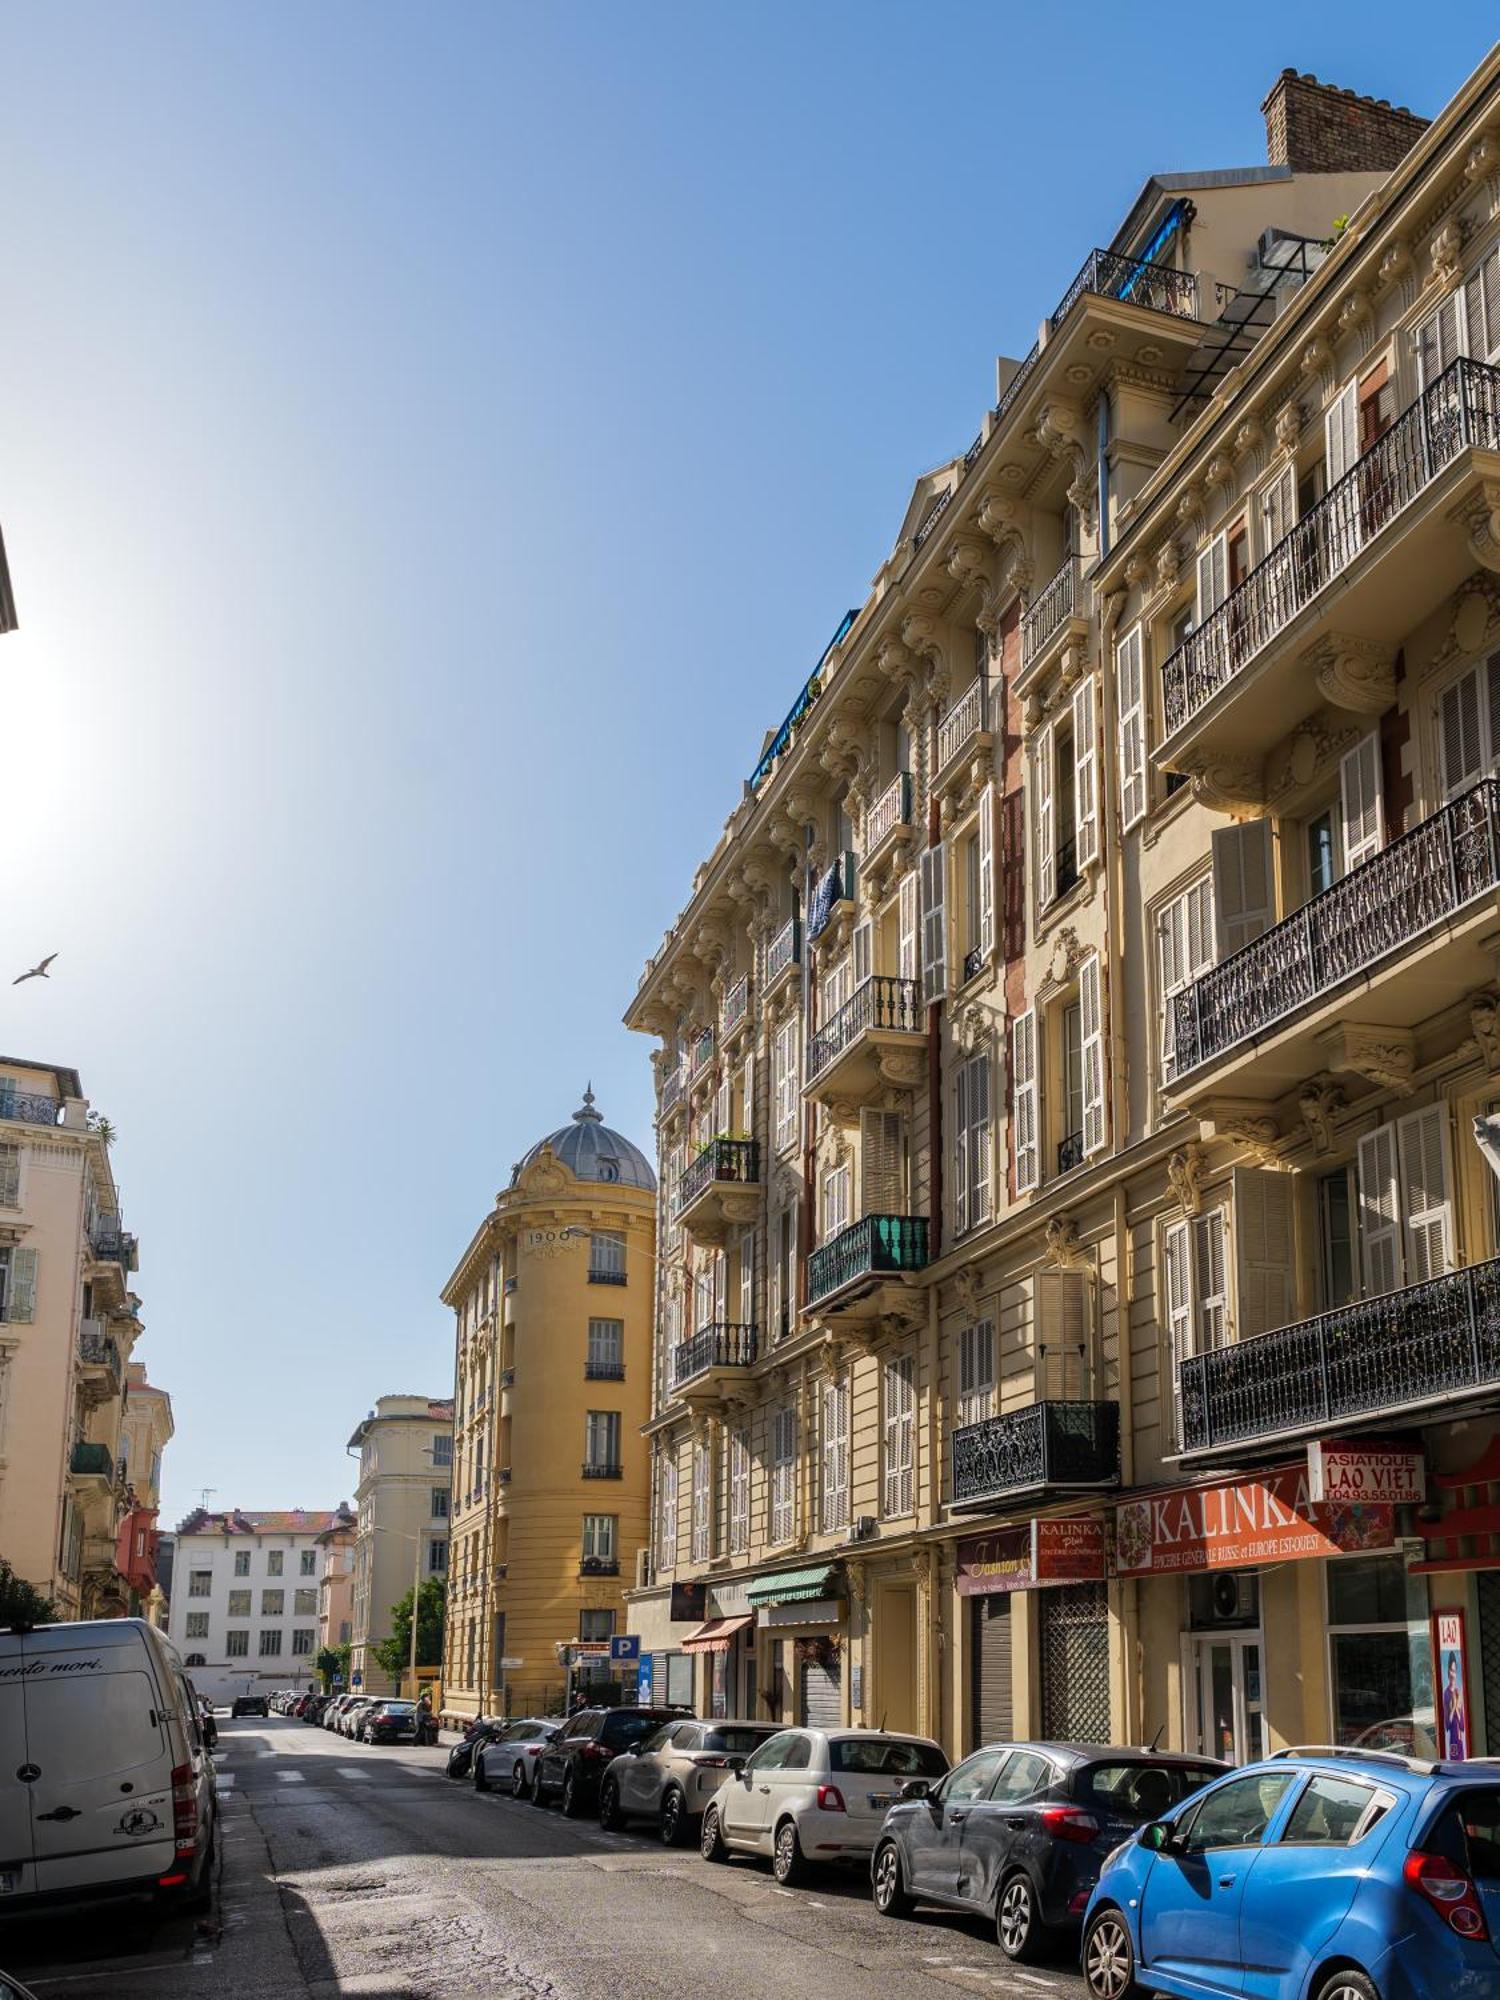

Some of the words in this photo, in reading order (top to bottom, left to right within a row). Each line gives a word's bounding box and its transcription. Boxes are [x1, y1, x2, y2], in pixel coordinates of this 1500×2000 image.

[529, 1231, 570, 1245] 1900
[1326, 1454, 1416, 1466] ASIATIQUE
[1327, 1467, 1364, 1489] LAO
[1371, 1467, 1417, 1489] VIET
[1153, 1472, 1319, 1545] KALINKA
[1040, 1524, 1102, 1536] KALINKA
[1248, 1539, 1278, 1557] EUROPE
[1279, 1534, 1320, 1554] EST-OUEST
[1441, 1619, 1457, 1644] LAO
[618, 1639, 632, 1656] P
[50, 1658, 102, 1673] mori.
